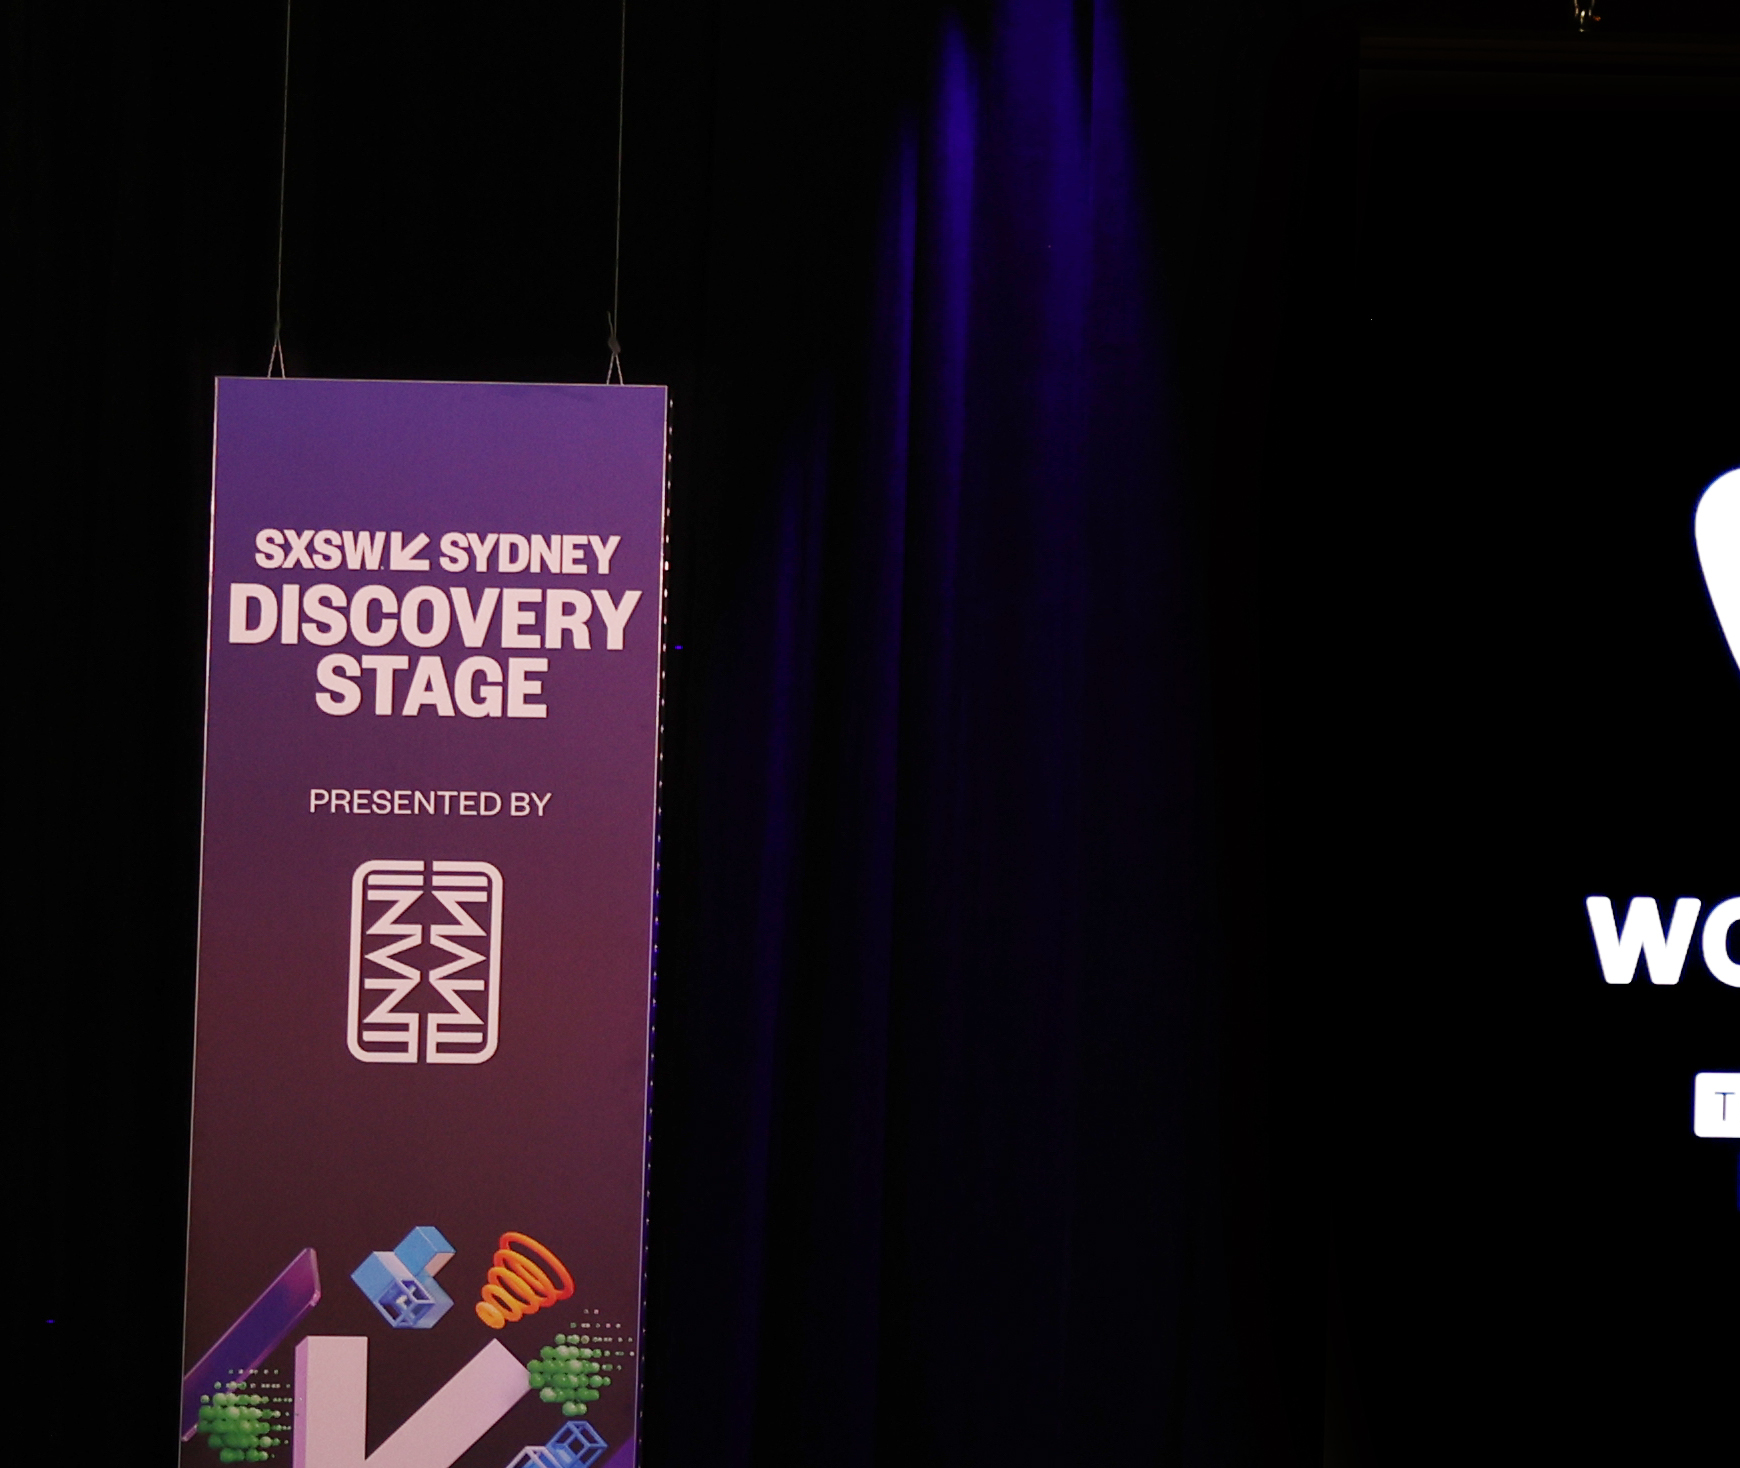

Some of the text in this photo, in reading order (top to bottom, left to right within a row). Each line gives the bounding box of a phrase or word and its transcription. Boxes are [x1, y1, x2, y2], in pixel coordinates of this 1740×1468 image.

[254, 528, 621, 575] SXSW SYDNEY
[228, 582, 642, 651] DISCOVERY
[315, 653, 549, 718] STAGE
[309, 788, 552, 817] PRESENTED BY
